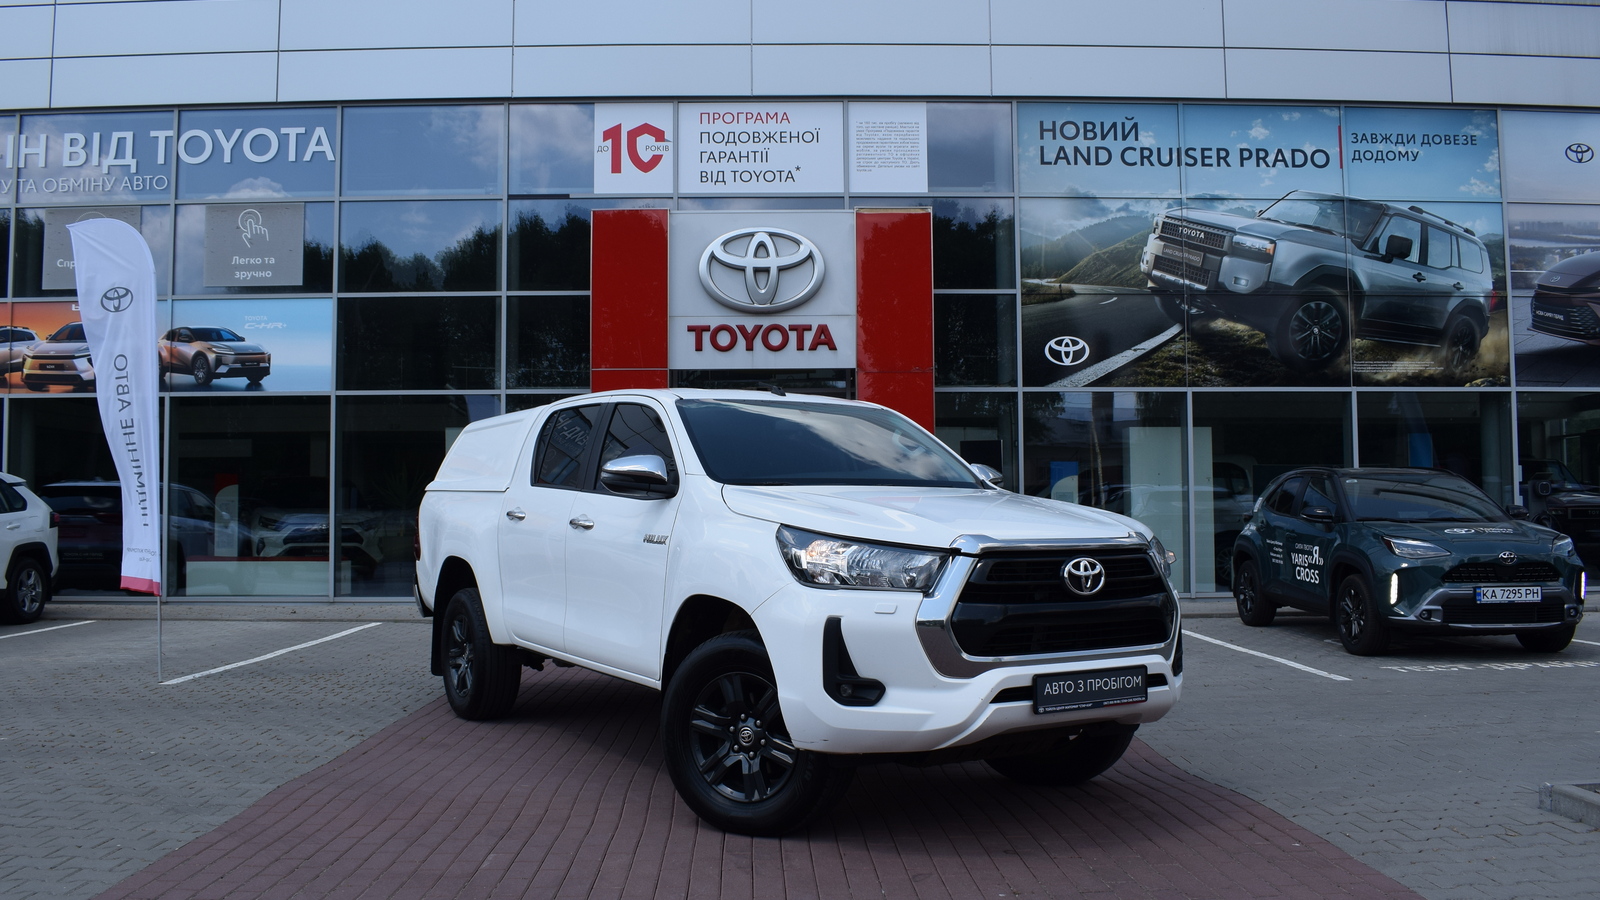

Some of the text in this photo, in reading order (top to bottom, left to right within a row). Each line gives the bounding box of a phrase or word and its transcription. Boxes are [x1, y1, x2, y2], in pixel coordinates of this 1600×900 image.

[700, 112, 790, 125] ПРОГРАМА
[700, 128, 820, 146] ПОДОВЖЕНОЇ
[1039, 117, 1139, 142] НОВИЙ
[1351, 133, 1478, 148] ЗАВЖДИ ДОВЕЗЕ
[0, 127, 335, 174] ІН ВІД TOYOTA
[597, 145, 609, 154] ДО
[645, 144, 670, 152] РОКІВ
[700, 149, 769, 164] ГАРАНТІЇ
[1351, 150, 1420, 163] ДОДОМУ
[1039, 146, 1331, 169] LAND CRUISER PRADO
[17, 178, 37, 193] ТА
[42, 177, 116, 193] ОБМІНУ
[120, 175, 168, 190] АВТО
[700, 171, 726, 185] ВІД
[1180, 228, 1204, 238] TOYOTA
[57, 258, 75, 270] Спр
[231, 256, 275, 266] Легко та
[234, 269, 272, 279] зручно
[687, 324, 837, 352] TOYOTA
[1291, 552, 1308, 567] YARIS
[1295, 566, 1320, 584] CROSS
[1482, 589, 1497, 599] KA
[1500, 588, 1522, 599] 7295
[1525, 588, 1539, 598] PH
[1044, 676, 1142, 695] АВТО З ПРОБІГОМ
